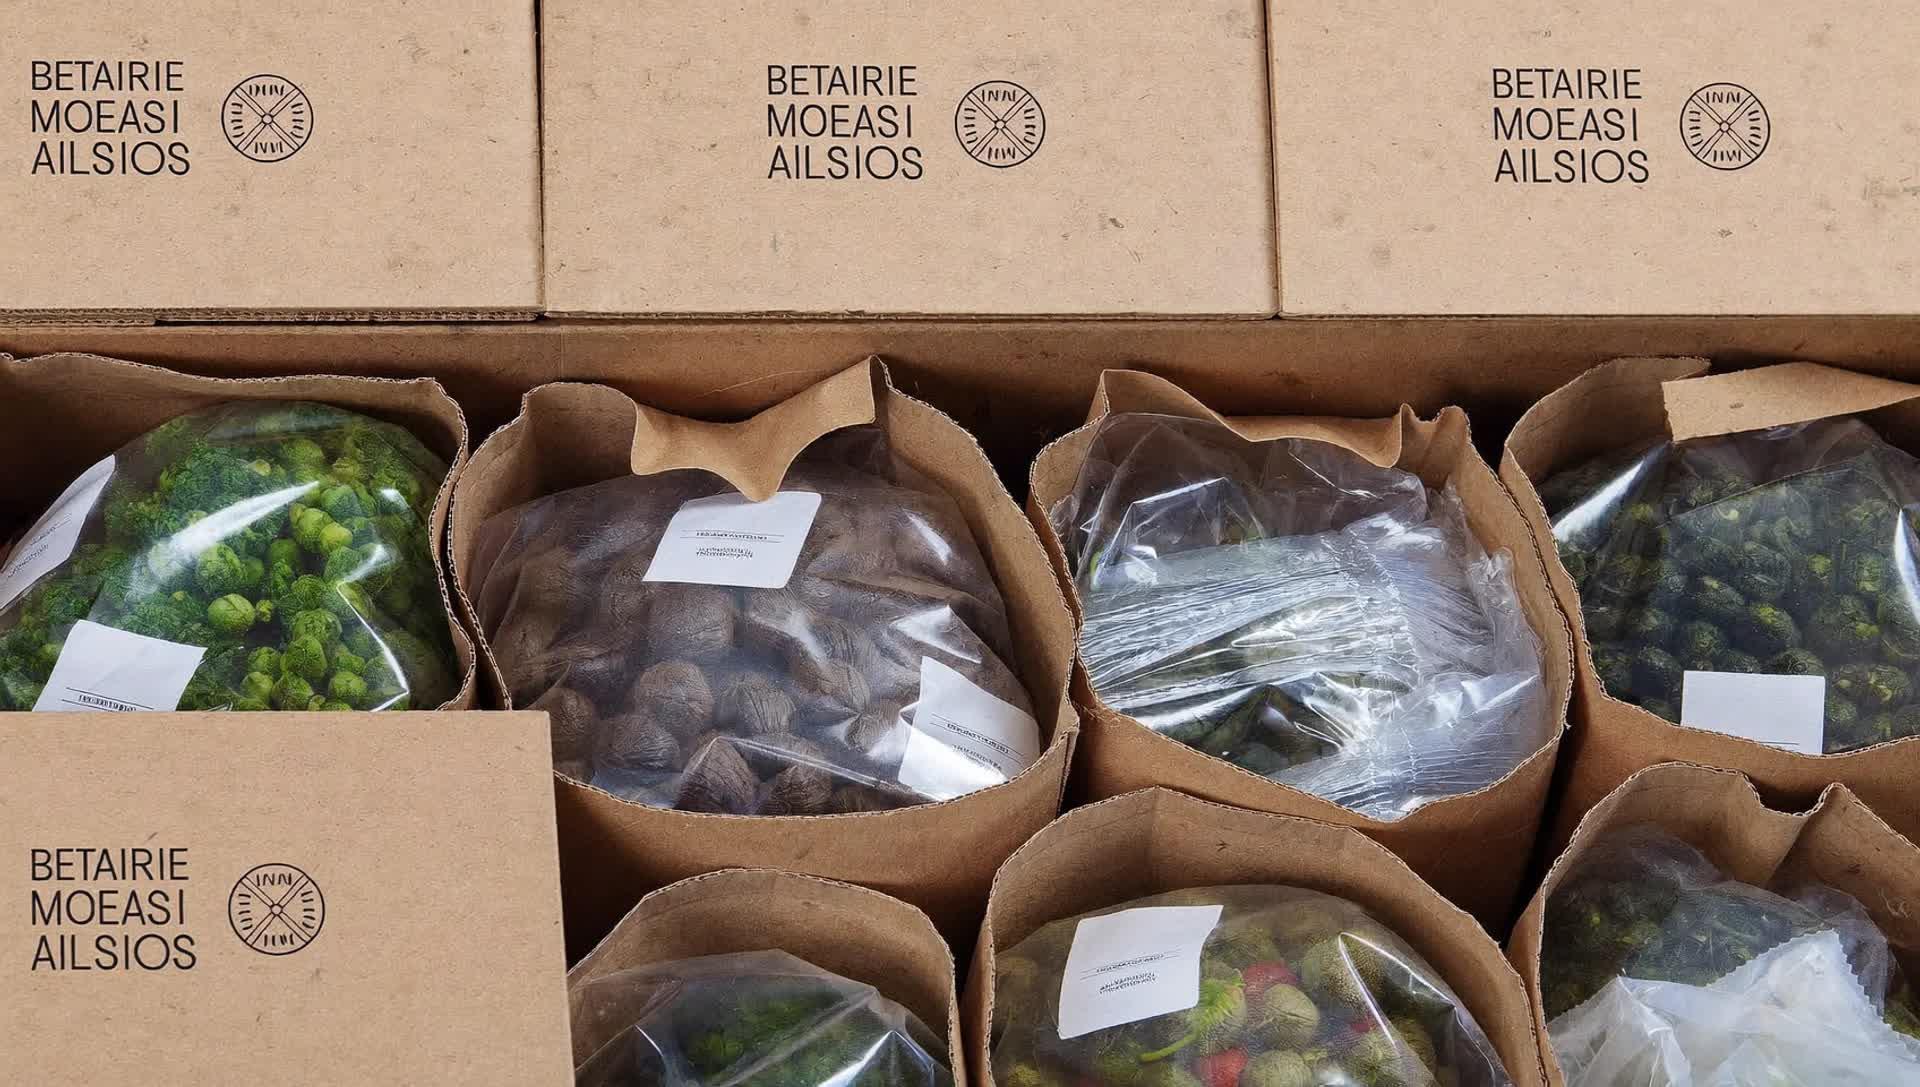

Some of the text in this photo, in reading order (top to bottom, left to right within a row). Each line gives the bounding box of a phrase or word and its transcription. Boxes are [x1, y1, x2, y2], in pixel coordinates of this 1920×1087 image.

[32, 61, 183, 91] BETAIRIE
[768, 65, 917, 96] BETAIRIE
[1493, 69, 1641, 99] BETAIRIE
[32, 100, 177, 133] MOEASI
[768, 104, 911, 138] MOEASI
[1494, 107, 1637, 141] MOEASI
[32, 141, 190, 175] AILSIOS
[768, 145, 922, 179] AILSIOS
[1495, 149, 1649, 183] AILSIOS
[31, 848, 189, 881] BETAIRIE
[32, 889, 184, 925] MOEASI
[32, 934, 196, 971] AILSIOS
